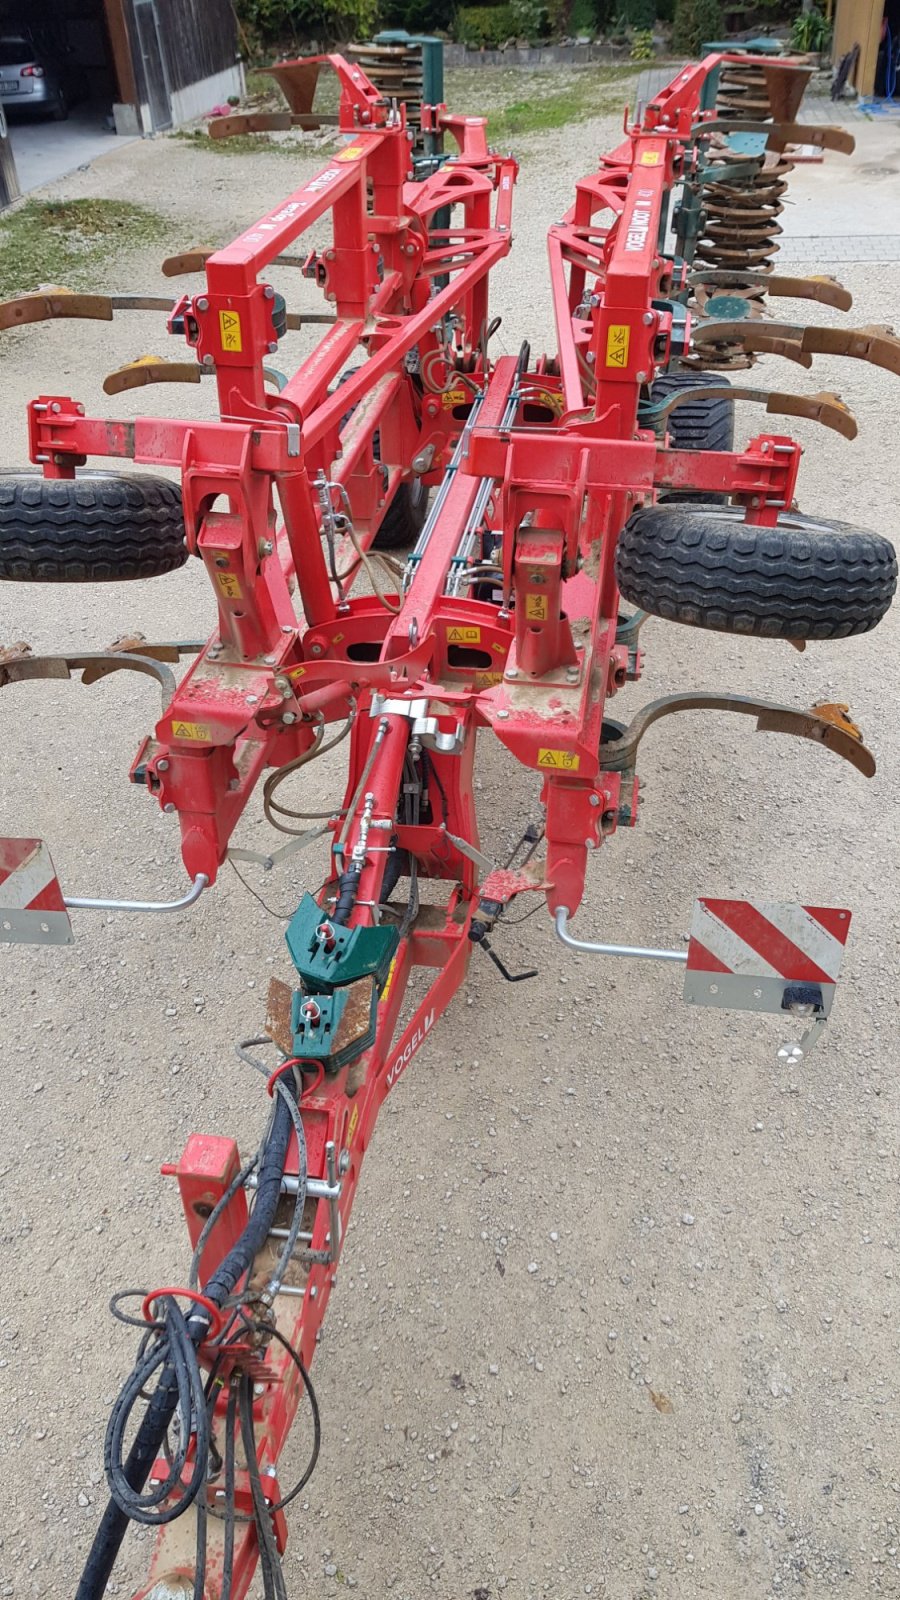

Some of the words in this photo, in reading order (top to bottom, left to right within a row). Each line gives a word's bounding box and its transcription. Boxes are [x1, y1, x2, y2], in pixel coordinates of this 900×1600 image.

[631, 209, 651, 225] NOOT
[624, 231, 648, 251] VOGEL
[386, 1028, 423, 1085] VOGEL
